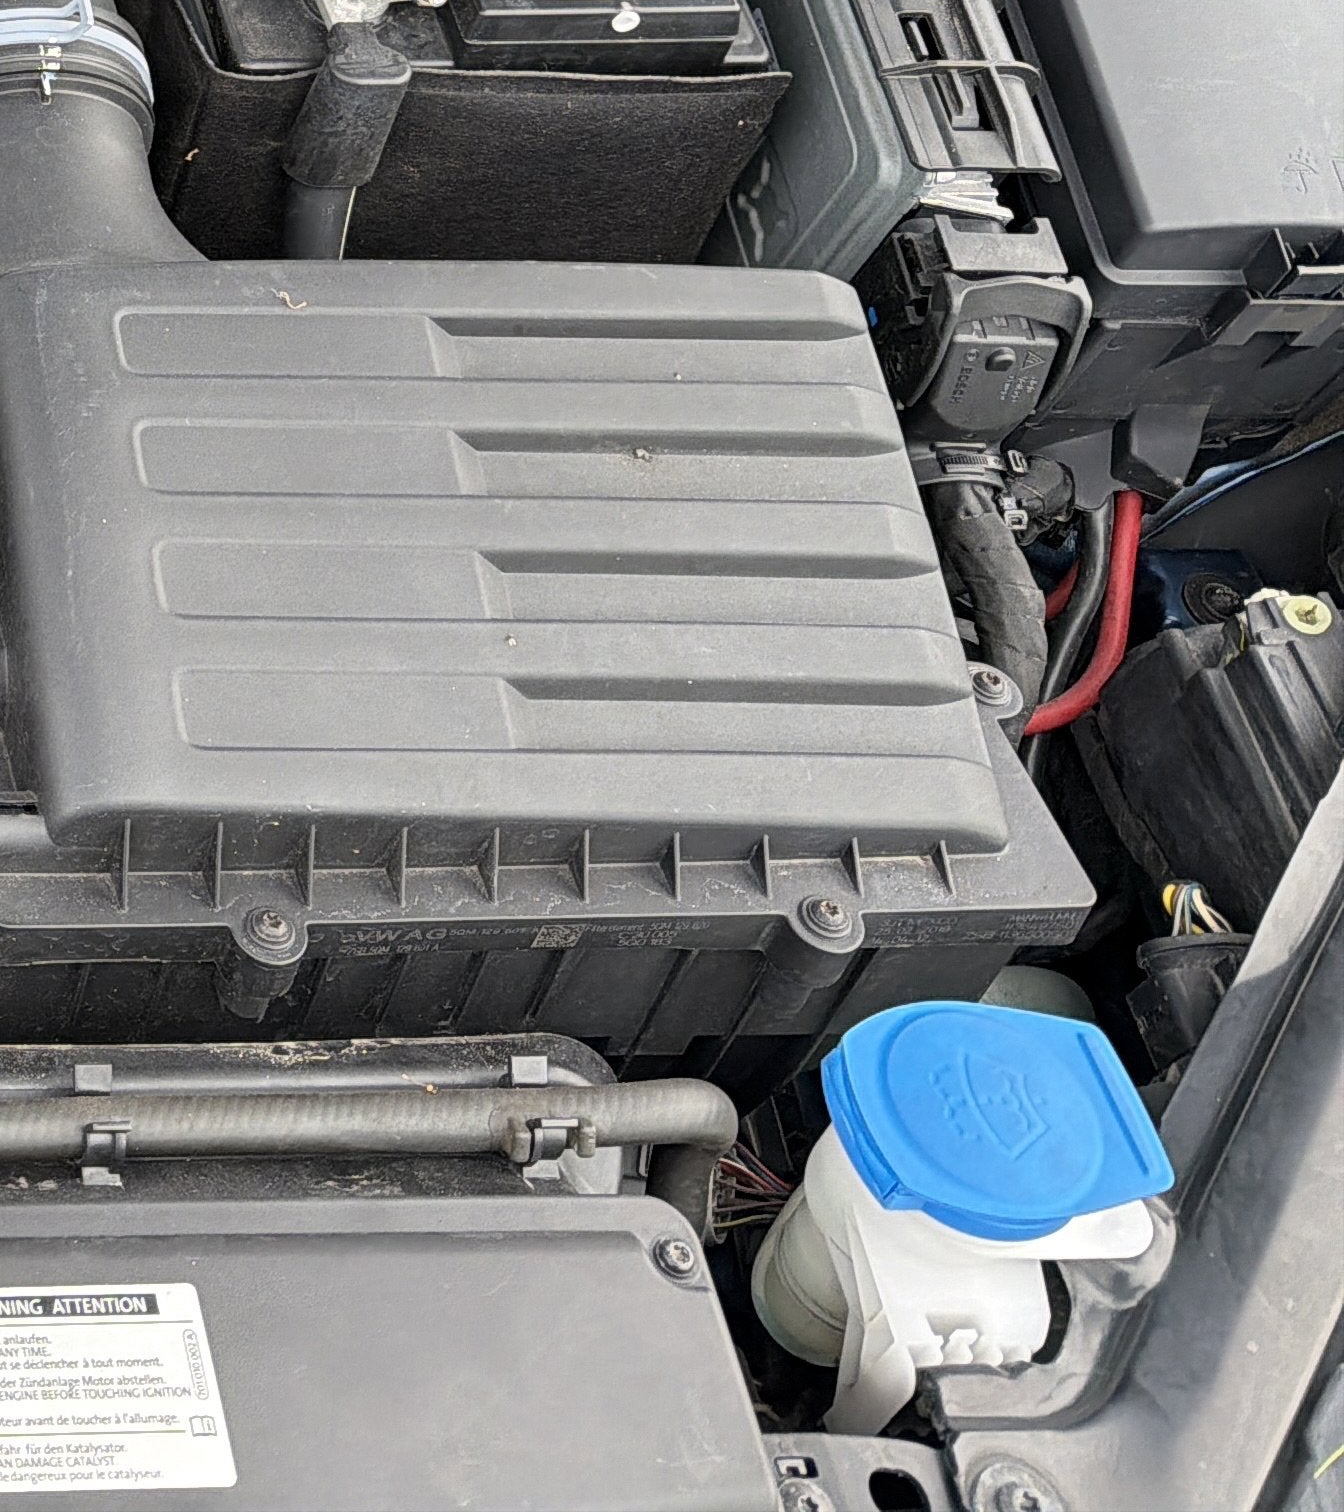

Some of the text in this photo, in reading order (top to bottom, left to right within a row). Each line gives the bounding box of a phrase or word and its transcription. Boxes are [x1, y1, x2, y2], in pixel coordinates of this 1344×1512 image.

[52, 1296, 147, 1316] ATTENTION
[21, 1347, 51, 1357] TIME.
[10, 1362, 21, 1370] se
[83, 1358, 89, 1368] à
[91, 1358, 113, 1368] tout
[116, 1357, 164, 1368] moment.
[0, 1378, 16, 1388] der
[19, 1376, 80, 1391] Zündanlage
[82, 1376, 114, 1386] Motor
[117, 1374, 167, 1385] abstellen.
[0, 1390, 39, 1401] ENGINE
[42, 1389, 81, 1400] BEFORE
[84, 1388, 140, 1399] TOUCHING
[143, 1387, 192, 1398] IGNITION
[25, 1416, 54, 1426] avant
[56, 1415, 69, 1425] de
[115, 1413, 121, 1423] à
[25, 1444, 41, 1455] für
[44, 1444, 64, 1455] den
[66, 1443, 128, 1456] Katalysator.
[16, 1457, 63, 1468] DAMAGE
[11, 1471, 66, 1485] dangereux
[70, 1471, 94, 1483] pour
[96, 1469, 106, 1480] le
